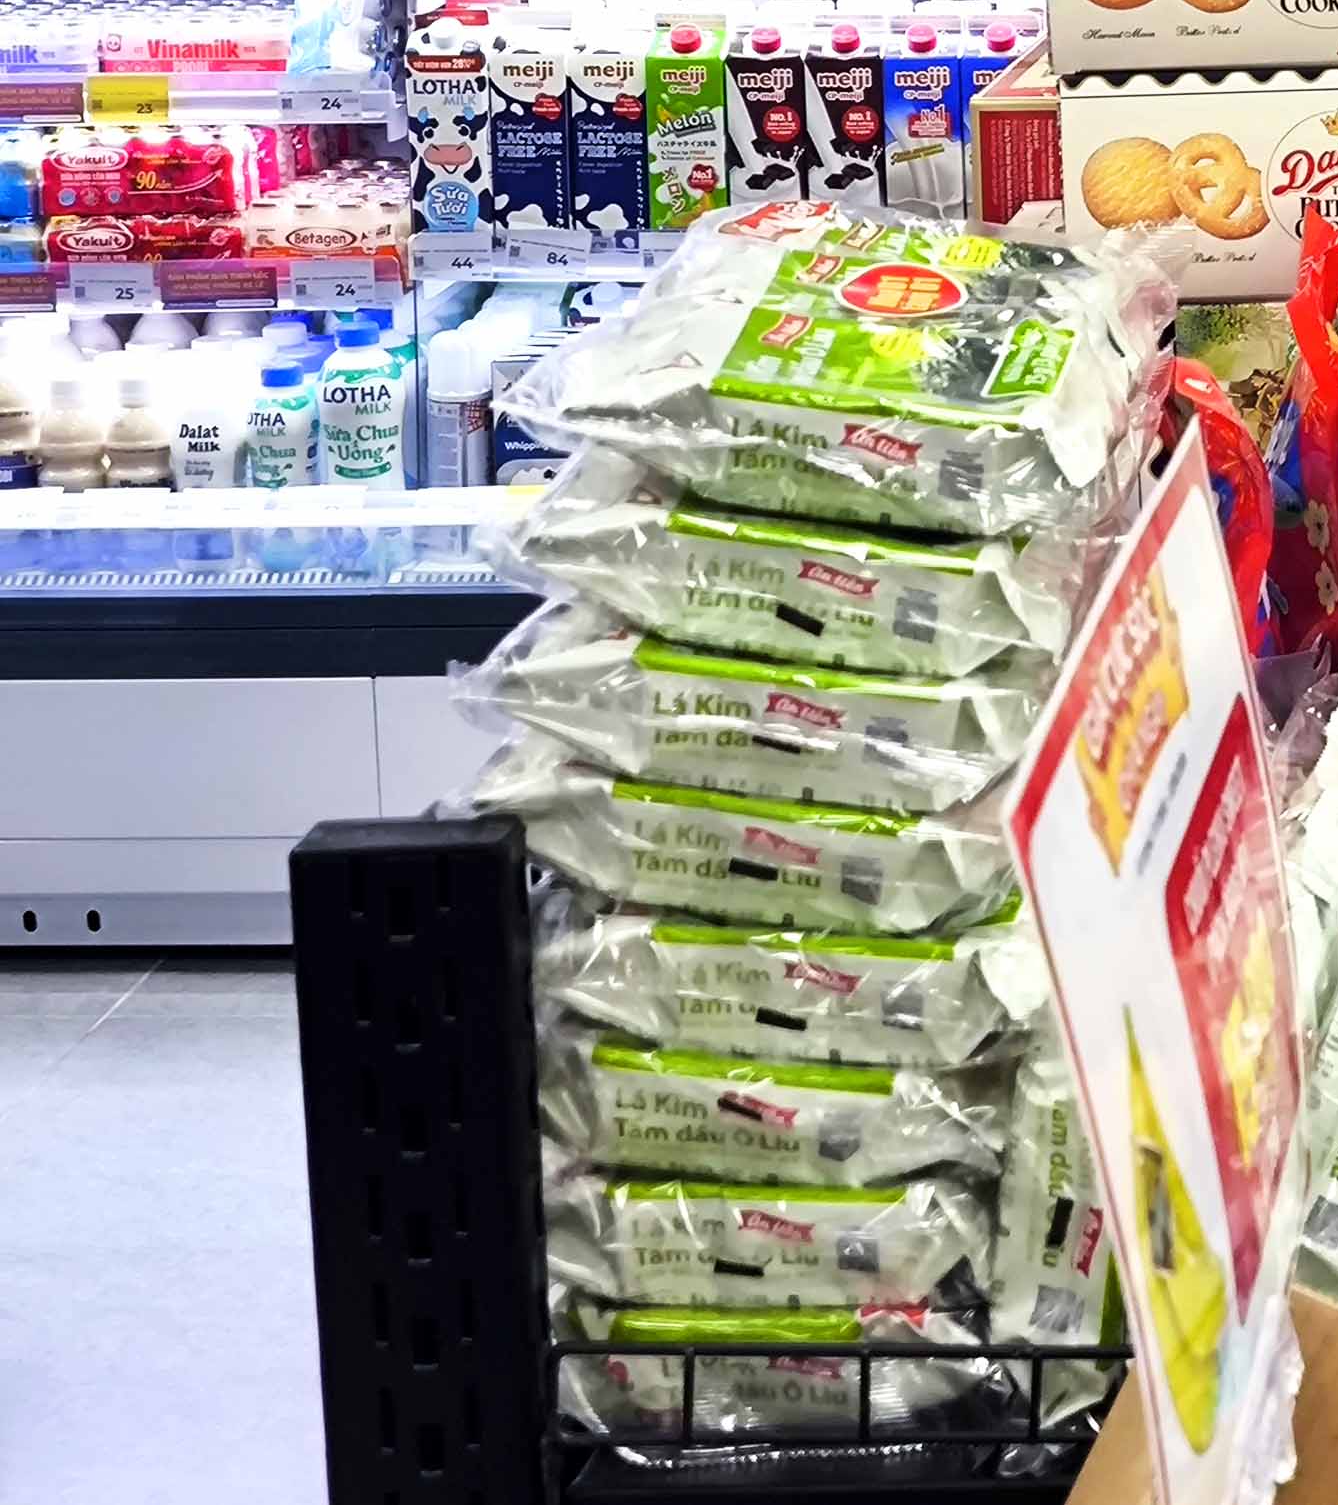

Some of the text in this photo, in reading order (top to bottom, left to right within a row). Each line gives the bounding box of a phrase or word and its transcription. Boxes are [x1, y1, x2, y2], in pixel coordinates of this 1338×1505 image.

[147, 38, 240, 59] Vinamilk
[413, 78, 478, 96] LOTHA
[136, 103, 153, 114] 23
[321, 98, 342, 110] 24
[443, 95, 477, 107] MILK
[657, 111, 714, 138] Melon
[496, 132, 563, 145] LACTOSE
[576, 132, 643, 145] LACTOSE
[66, 150, 117, 167] Yakult
[432, 183, 469, 202] Sữa
[431, 199, 468, 216] Tươi
[72, 234, 122, 249] Yakult
[294, 230, 347, 247] Betagen
[451, 257, 474, 269] 44
[546, 252, 569, 266] 84
[115, 287, 134, 300] 25
[322, 384, 392, 404] LOTHA
[354, 401, 392, 415] MILK
[355, 423, 399, 443] Chua
[695, 695, 753, 721] Kim
